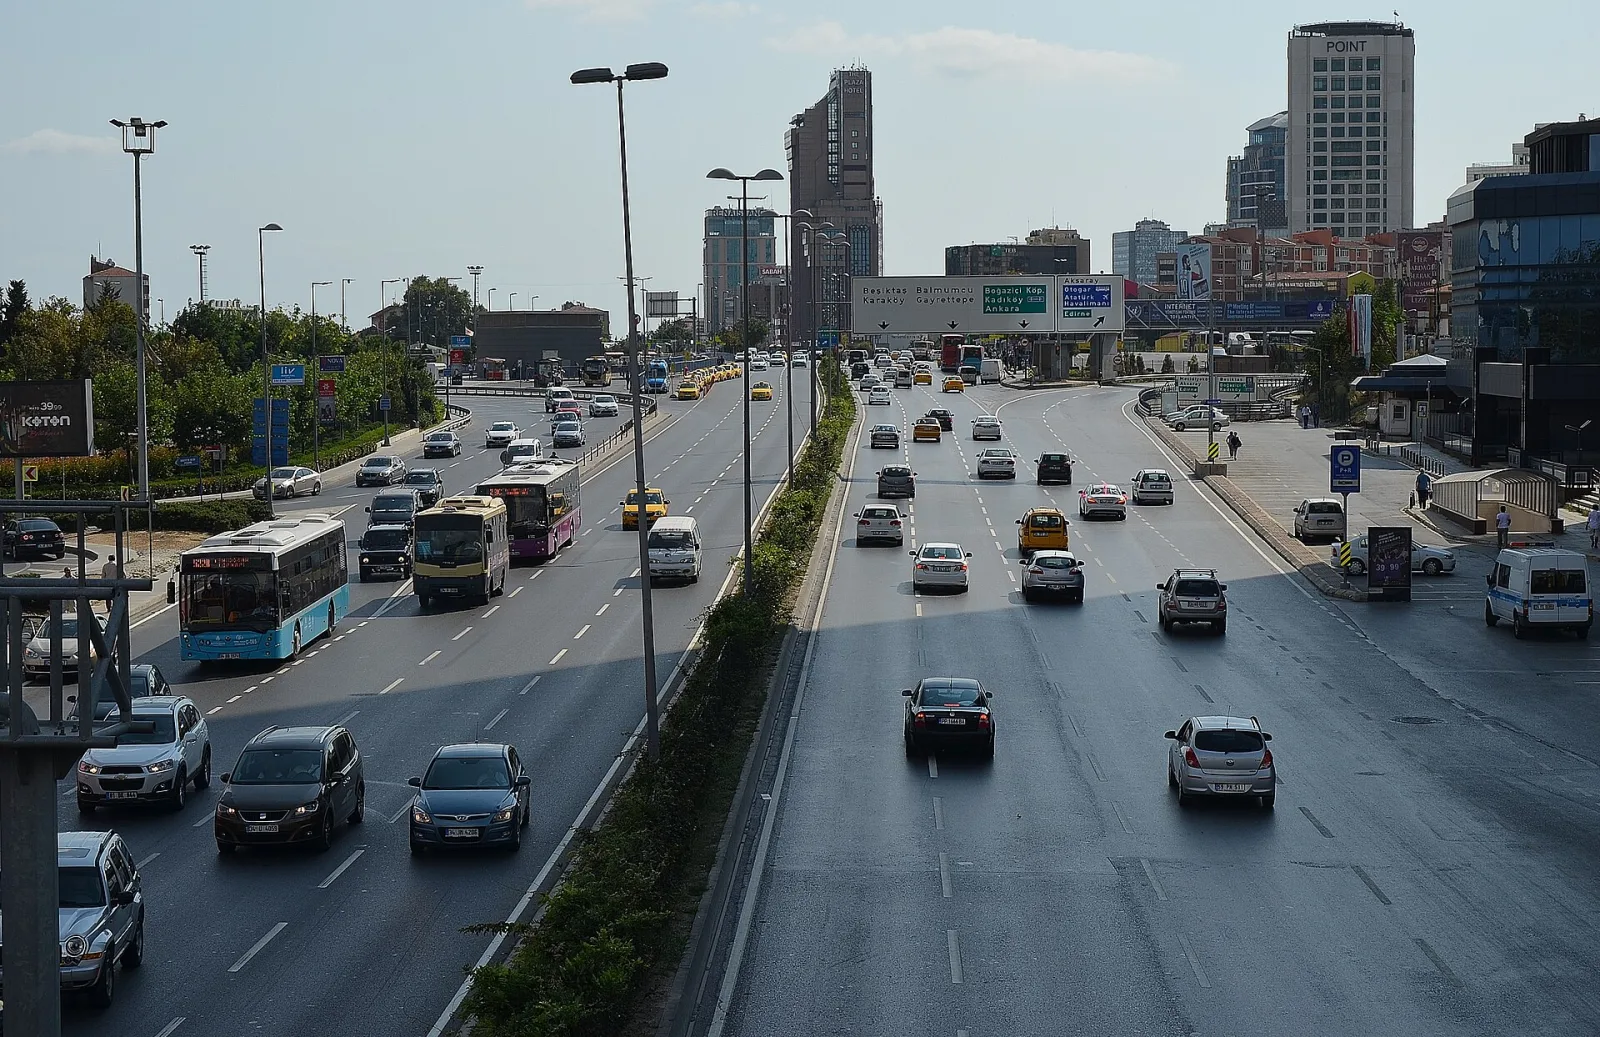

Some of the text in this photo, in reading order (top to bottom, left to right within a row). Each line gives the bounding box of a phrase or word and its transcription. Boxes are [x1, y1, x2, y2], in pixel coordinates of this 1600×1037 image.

[1326, 40, 1367, 52] POINT
[863, 286, 974, 295] Beşiktaş Balmumcu
[1026, 286, 1045, 295] Köp.
[1064, 286, 1091, 294] Otogar
[863, 296, 975, 306] Karaköy Gayrettepe
[984, 296, 1024, 304] Kadıköy
[280, 366, 296, 374] liv
[21, 416, 71, 427] KOTON
